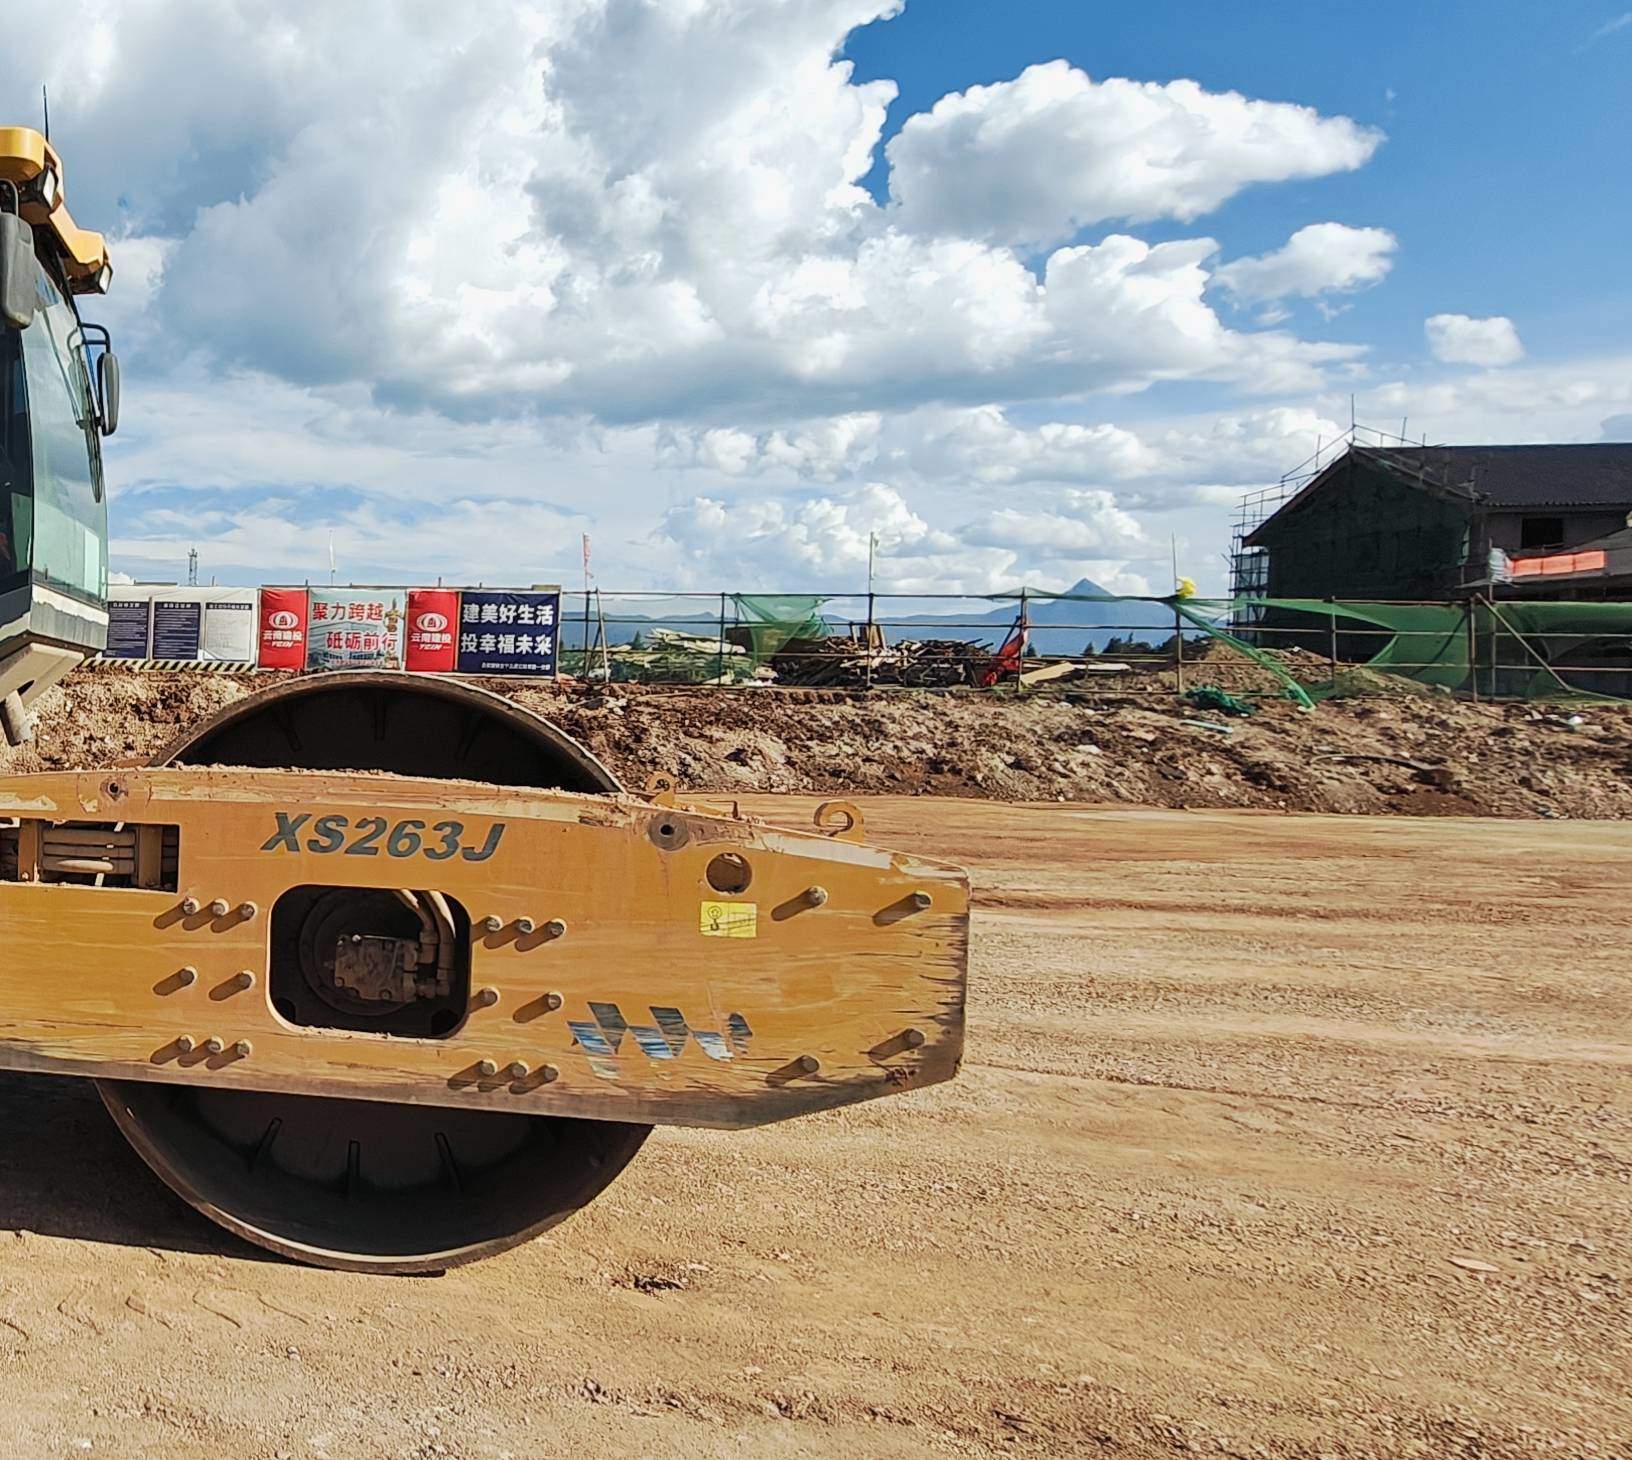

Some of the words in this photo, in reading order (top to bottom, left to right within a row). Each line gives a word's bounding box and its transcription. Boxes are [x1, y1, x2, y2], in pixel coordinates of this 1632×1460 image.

[313, 602, 384, 621] 聚力跨越
[462, 604, 554, 625] 建美好生活
[326, 631, 398, 651] 砥砺前行
[461, 632, 552, 656] 投幸福未来
[260, 812, 505, 861] XS263J
